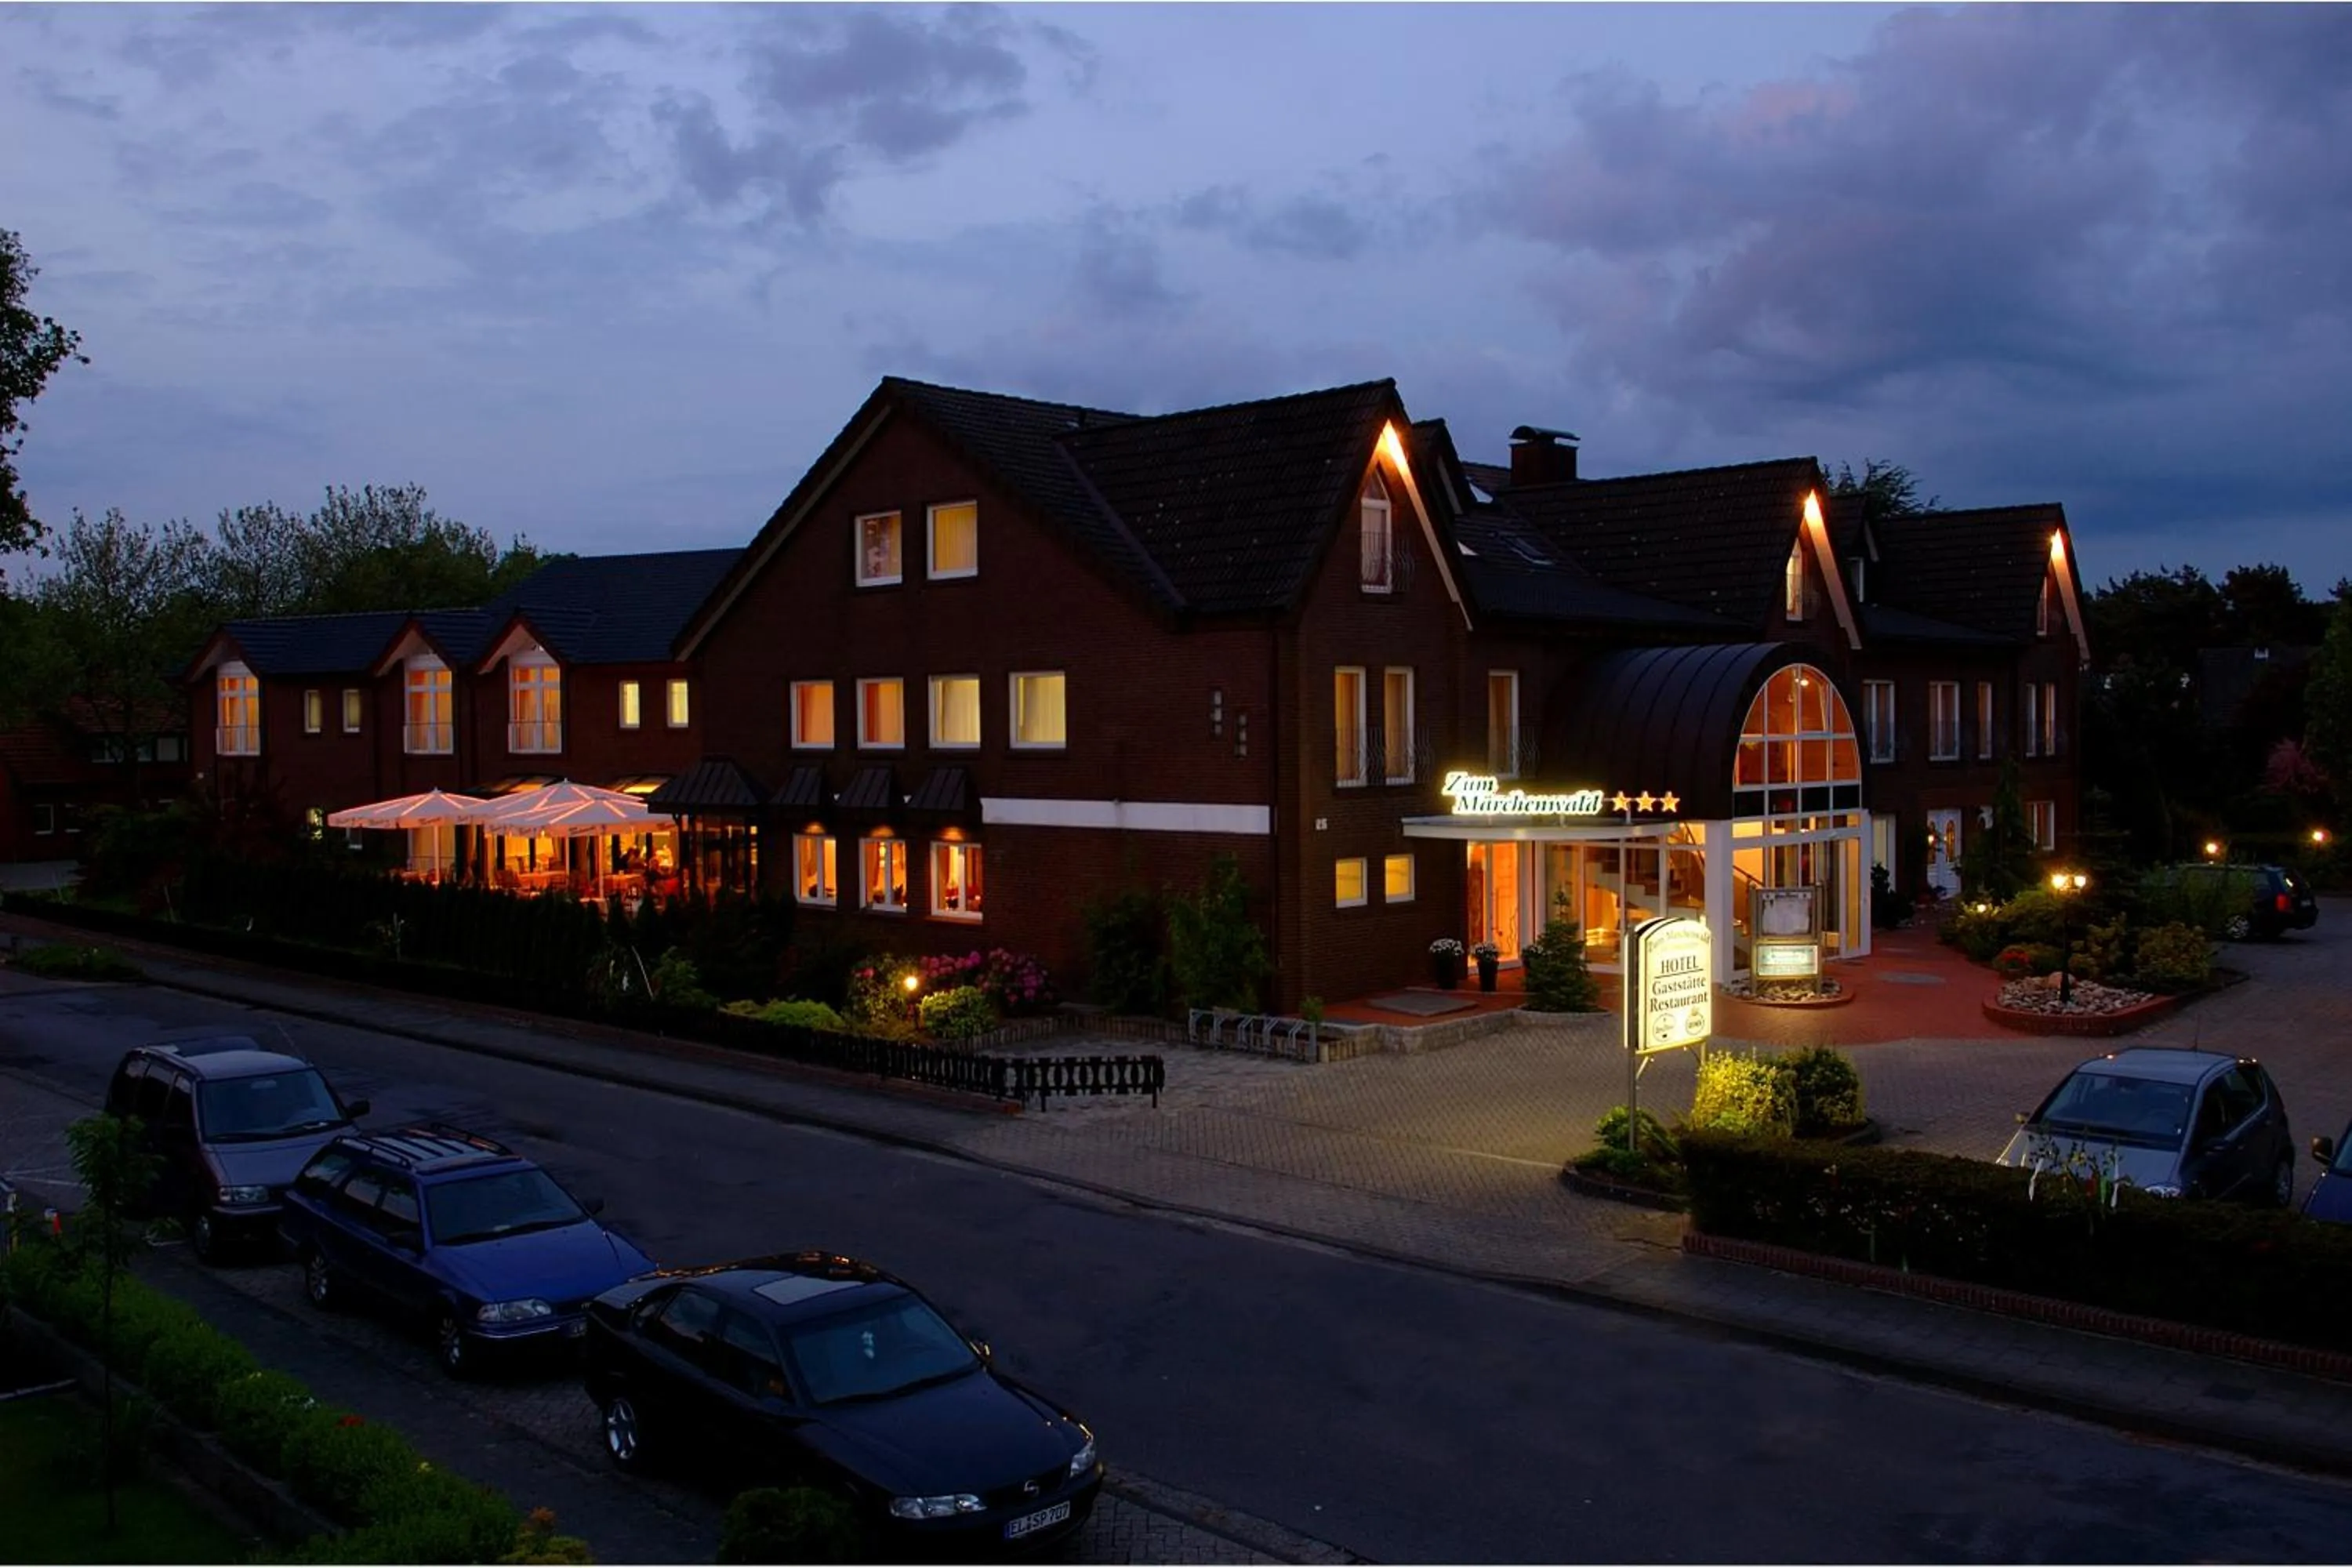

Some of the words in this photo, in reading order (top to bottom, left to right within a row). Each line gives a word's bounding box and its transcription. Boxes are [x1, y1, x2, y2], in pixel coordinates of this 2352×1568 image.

[1444, 773, 1496, 793] Zum
[1455, 792, 1602, 813] Märchenwald
[1661, 955, 1699, 975] HOTEL
[1652, 976, 1707, 996] Gaststätte
[1650, 991, 1708, 1013] Restaurant
